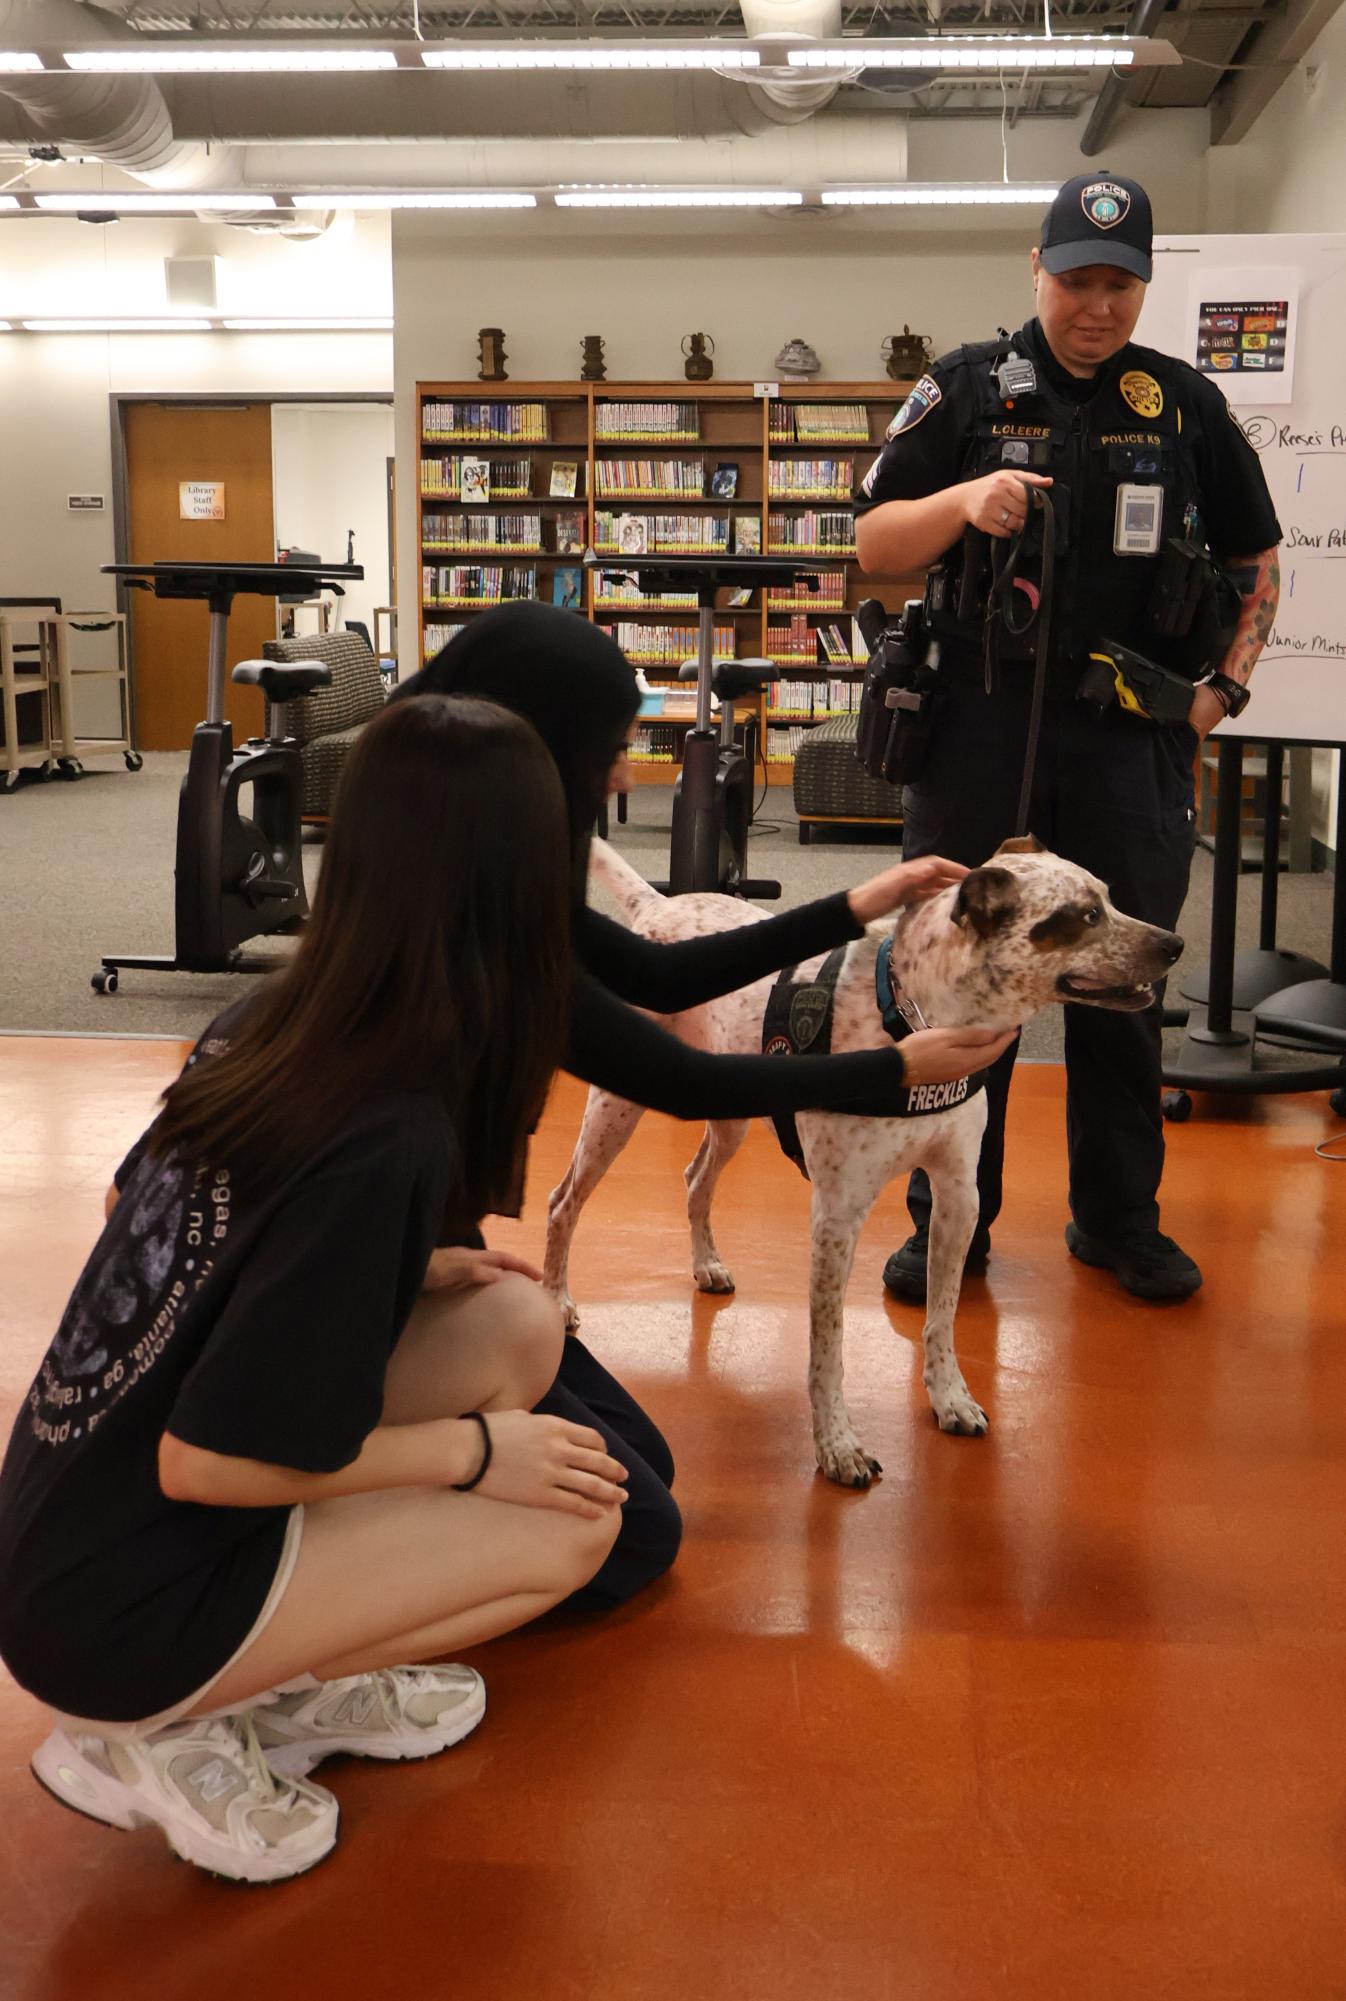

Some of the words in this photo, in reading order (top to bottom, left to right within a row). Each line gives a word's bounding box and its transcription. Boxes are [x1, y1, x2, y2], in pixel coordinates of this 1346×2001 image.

[1085, 184, 1129, 201] POLICE
[1101, 433, 1145, 446] POLICE
[1147, 434, 1161, 446] K9
[188, 485, 217, 497] Library
[193, 496, 212, 504] Staff
[193, 506, 213, 516] Only
[1286, 526, 1323, 549] Sour
[1265, 627, 1308, 650] Junior
[907, 1075, 969, 1112] FRECKLES
[127, 1280, 185, 1361] atlanta,
